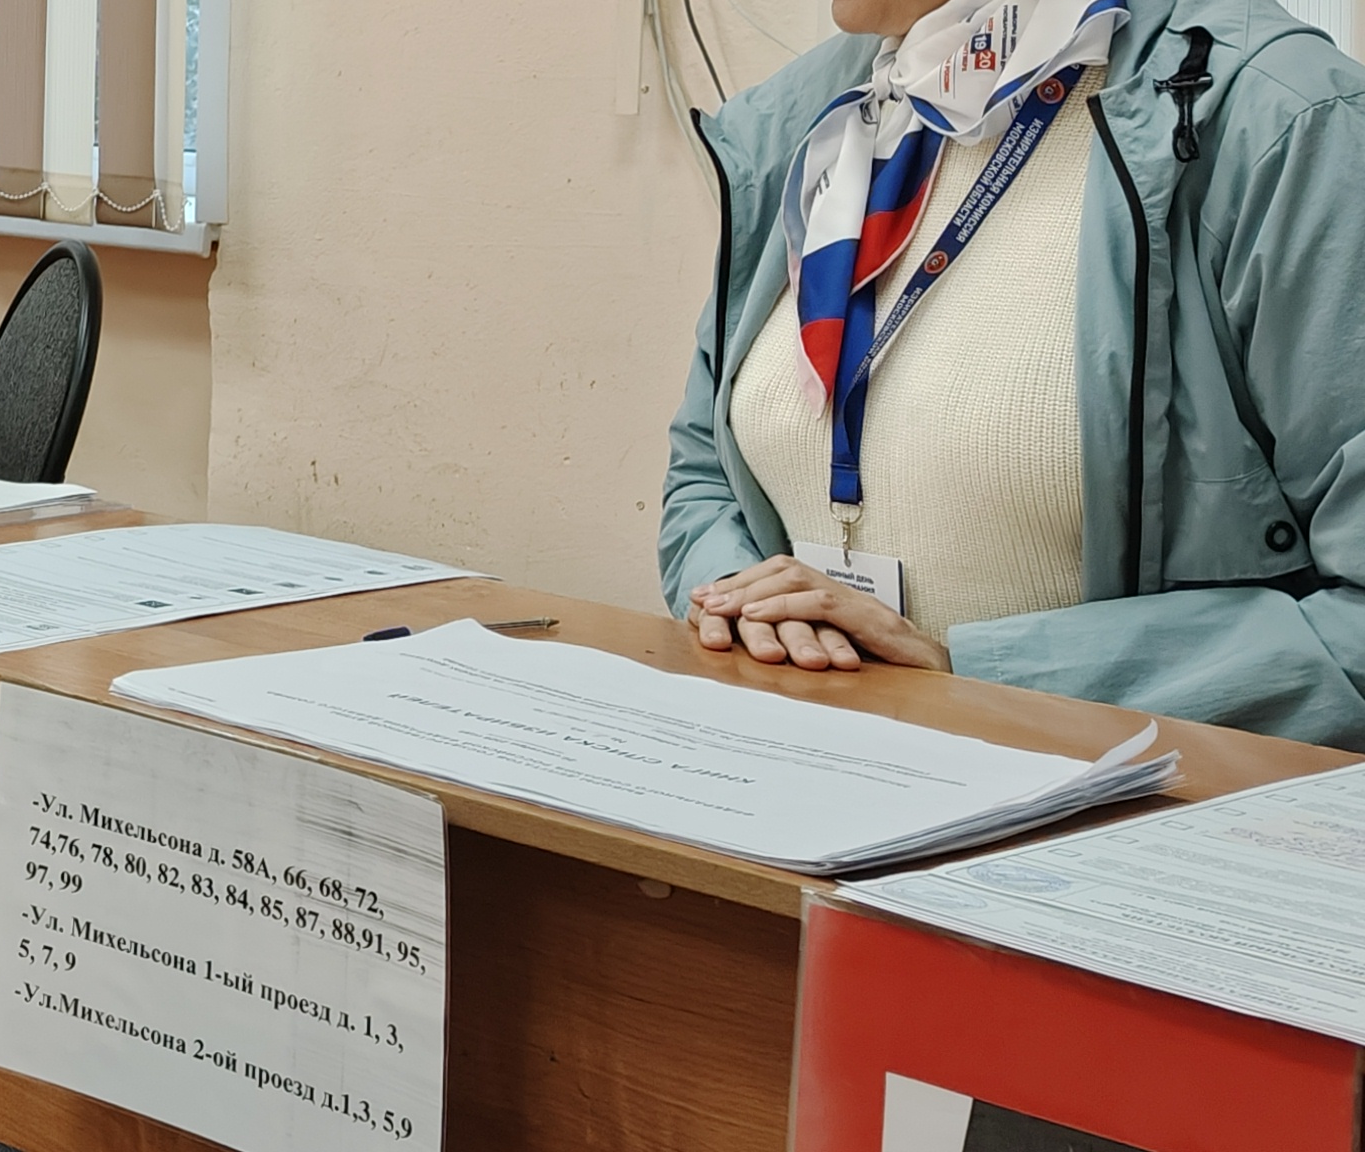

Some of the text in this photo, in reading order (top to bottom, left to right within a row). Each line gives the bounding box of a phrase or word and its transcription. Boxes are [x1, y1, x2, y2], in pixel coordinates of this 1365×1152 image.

[975, 35, 990, 68] 19 20
[953, 122, 1025, 227] МОСКОВСКОЙ ОБЛАСТИ
[956, 118, 1044, 243] ИЗБИРАТЕЛЬНАЯ КОМИССИЯ
[386, 692, 557, 735] ИЗБИРАТЕЛЕЙ
[559, 735, 663, 764] СПИСКА
[666, 763, 755, 783] КНИГА
[25, 861, 83, 893] 97, 99
[32, 792, 386, 921] -Ул. Михельсона д. 58А, 66, 68, 72,
[30, 826, 426, 976] 74,76, 78, 80, 82, 83, 84, 85, 87, 88,91, 95,
[18, 938, 76, 971] 5, 7, 9
[22, 904, 404, 1054] -Ул. Михельсона 1-ый проезд д. 1, 3,
[14, 982, 412, 1141] -Ул.Михельсона 2-ой проезд д.1,3, 5,9
